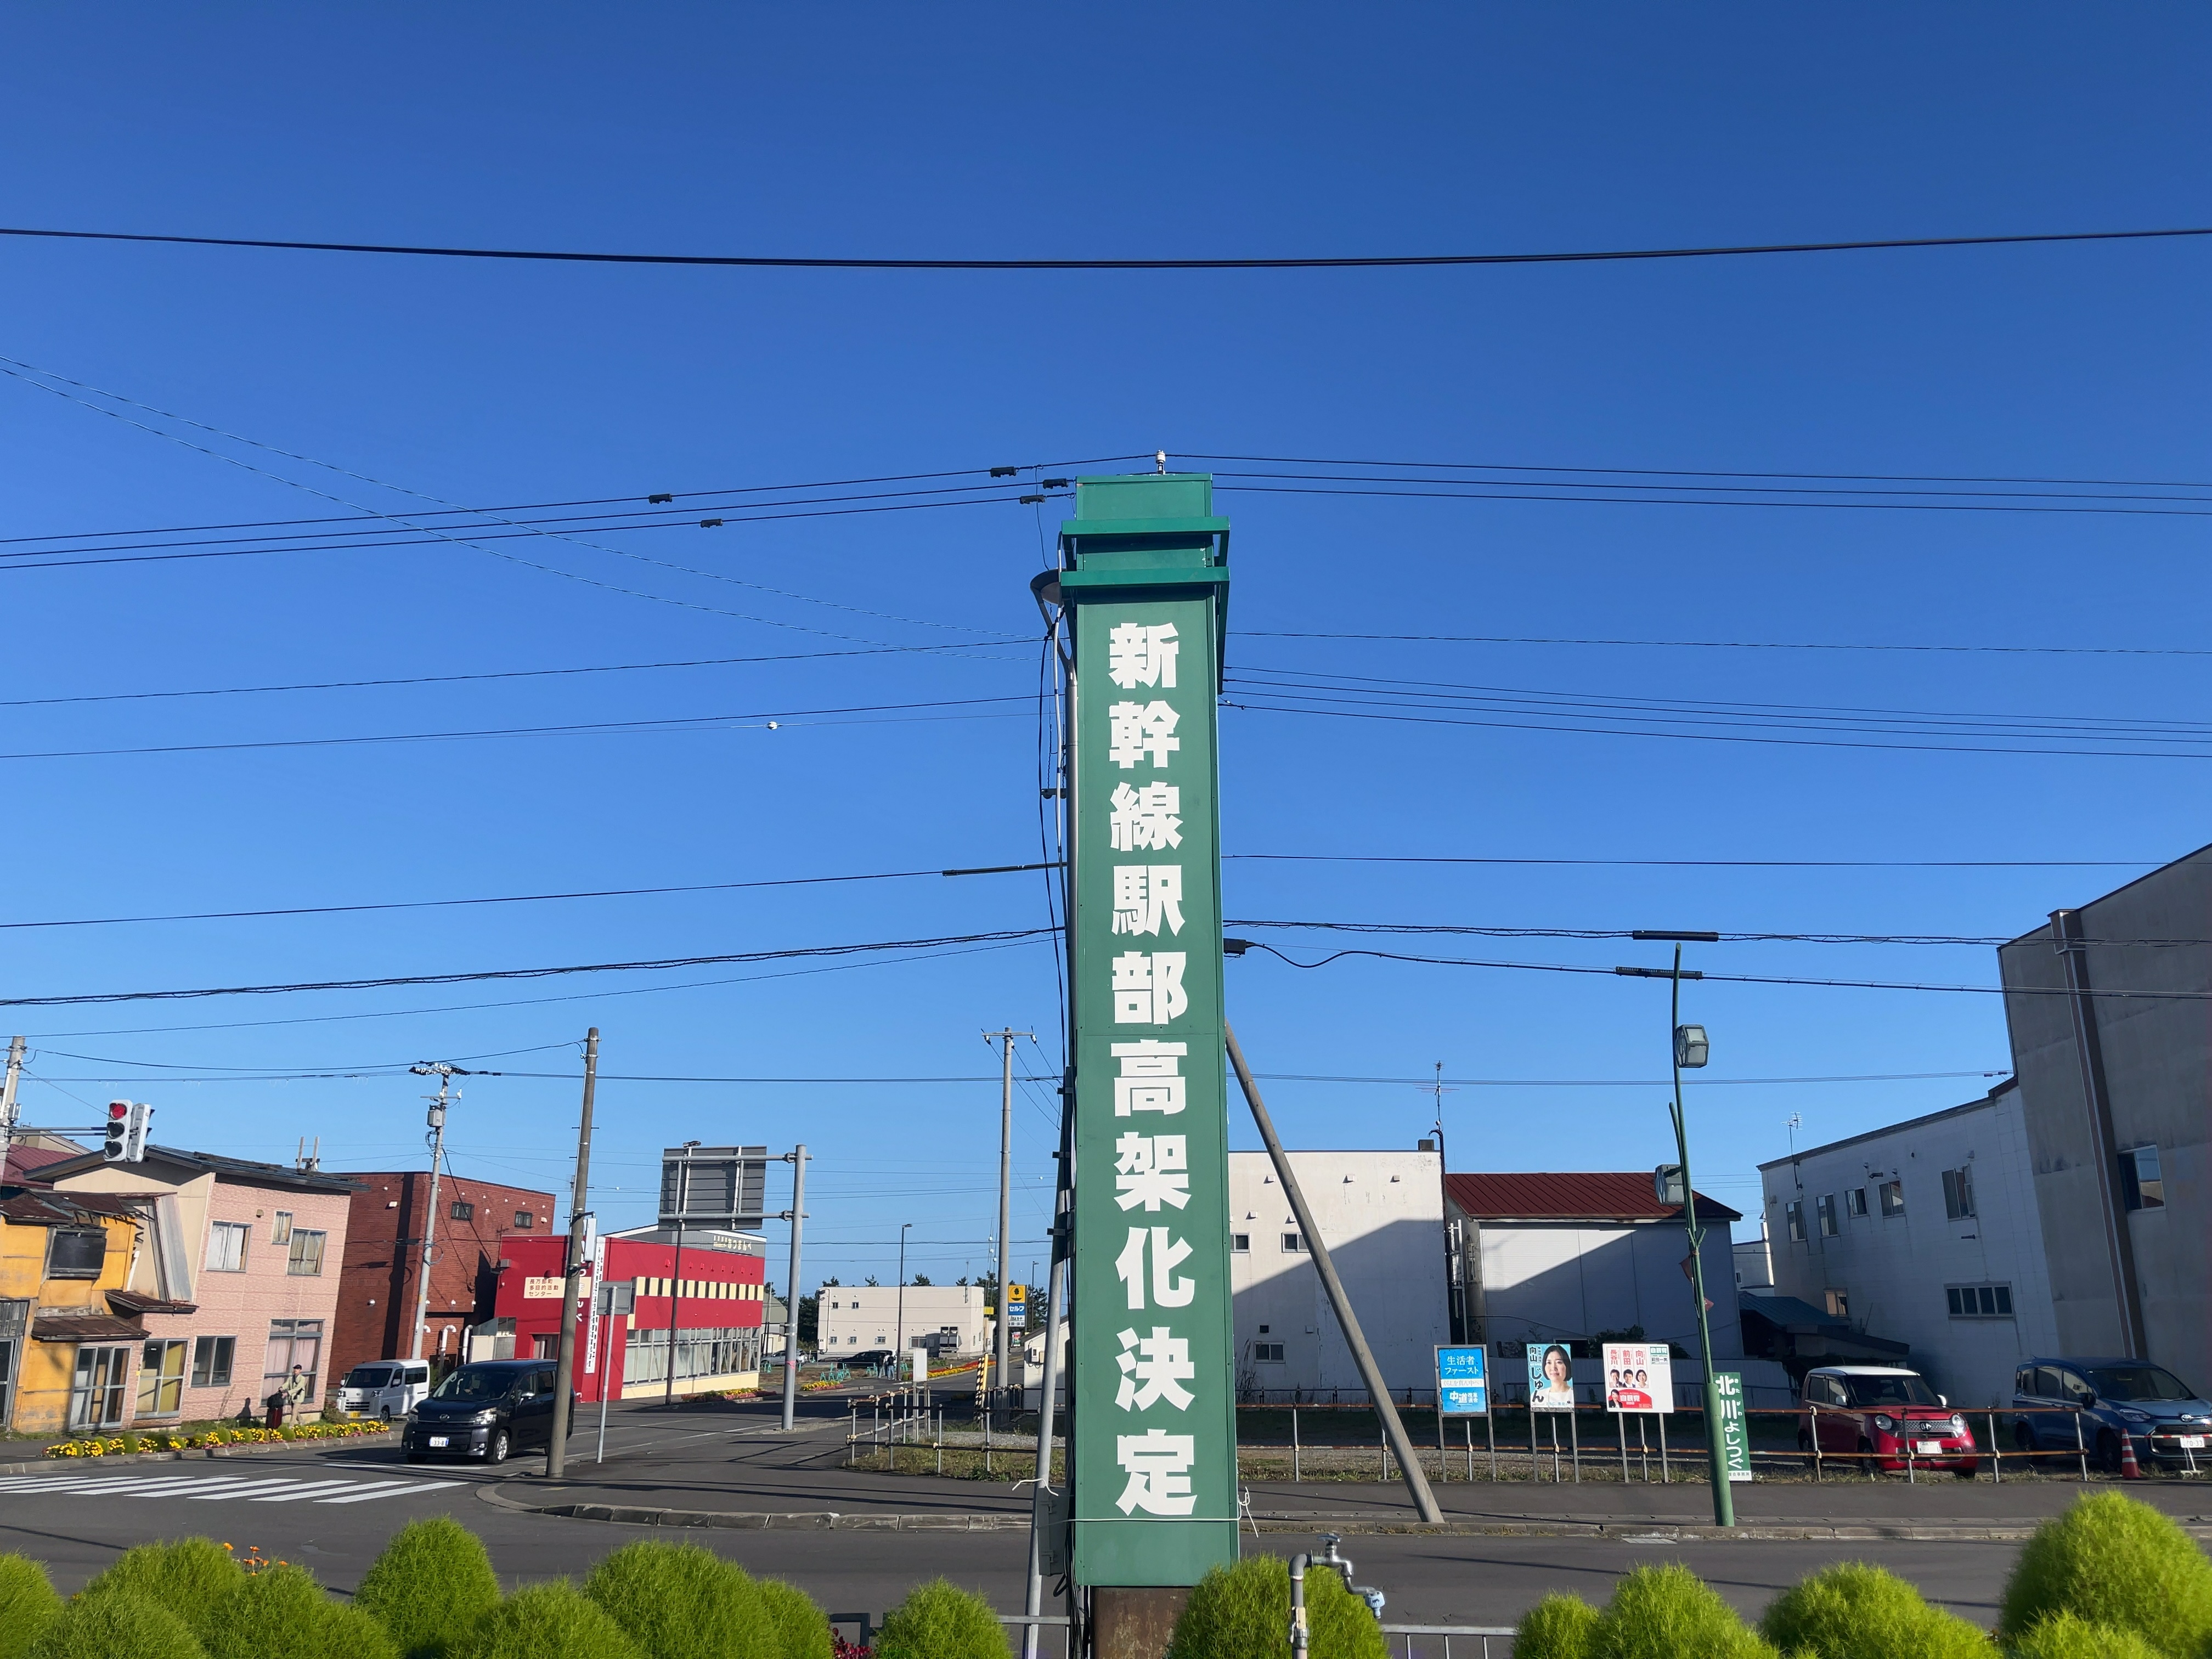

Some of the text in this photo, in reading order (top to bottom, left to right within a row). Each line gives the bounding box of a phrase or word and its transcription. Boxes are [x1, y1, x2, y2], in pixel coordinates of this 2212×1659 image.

[1109, 622, 1198, 1516] 新幹線駅部高架化決定
[1447, 1355, 1475, 1365] 生活者
[1623, 1350, 1631, 1365] 前田
[1635, 1350, 1644, 1365] 向山
[1444, 1366, 1479, 1375] ファースト
[1531, 1367, 1544, 1403] じゅん
[1449, 1391, 1468, 1403] 中道
[1715, 1375, 1744, 1469] 北川よしつぐ
